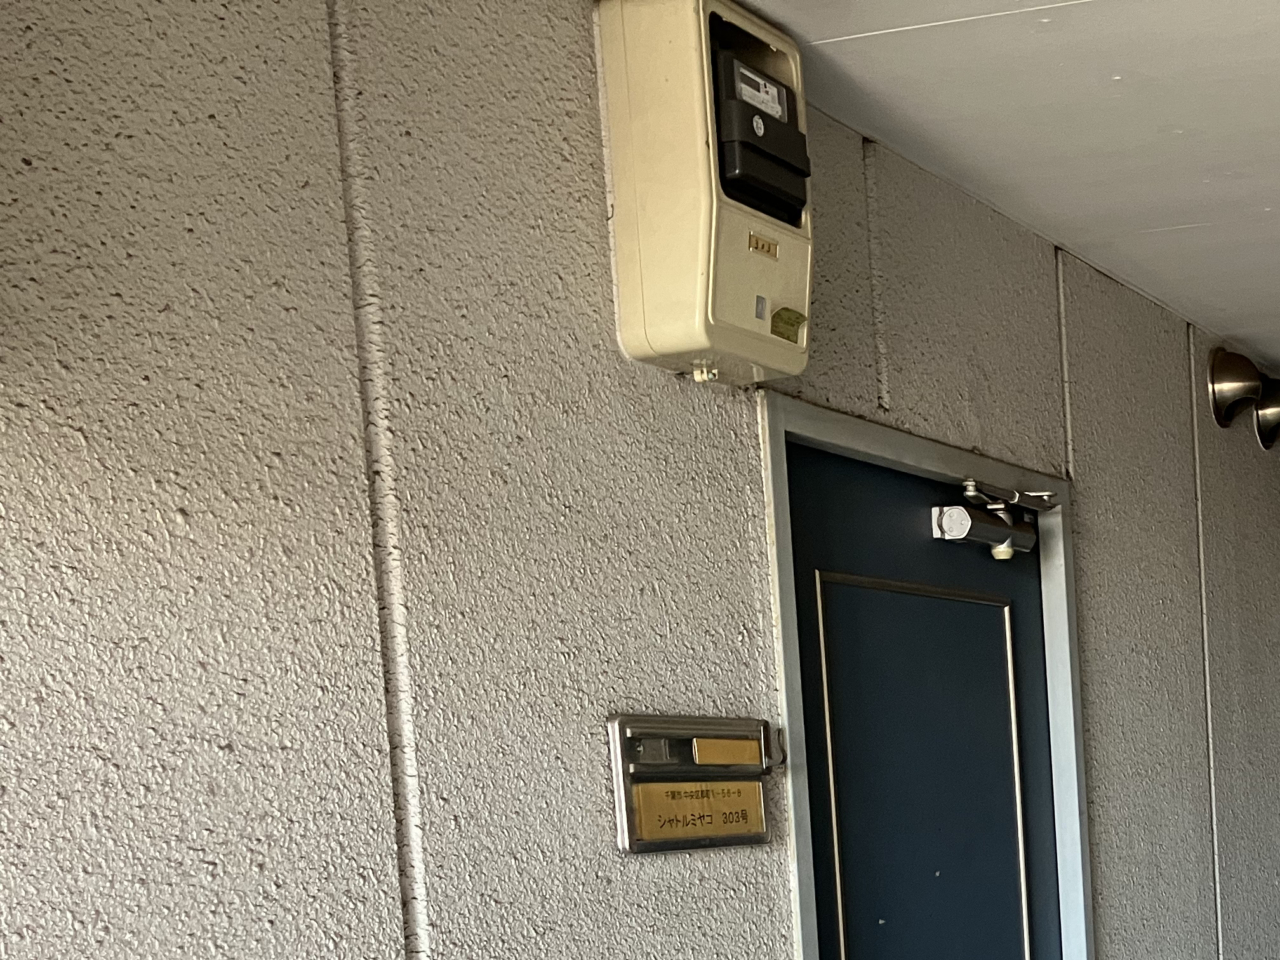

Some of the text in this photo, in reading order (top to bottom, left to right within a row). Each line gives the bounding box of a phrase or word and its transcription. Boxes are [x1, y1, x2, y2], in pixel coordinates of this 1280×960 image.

[657, 808, 748, 829] シャトルミヤコ 303号
